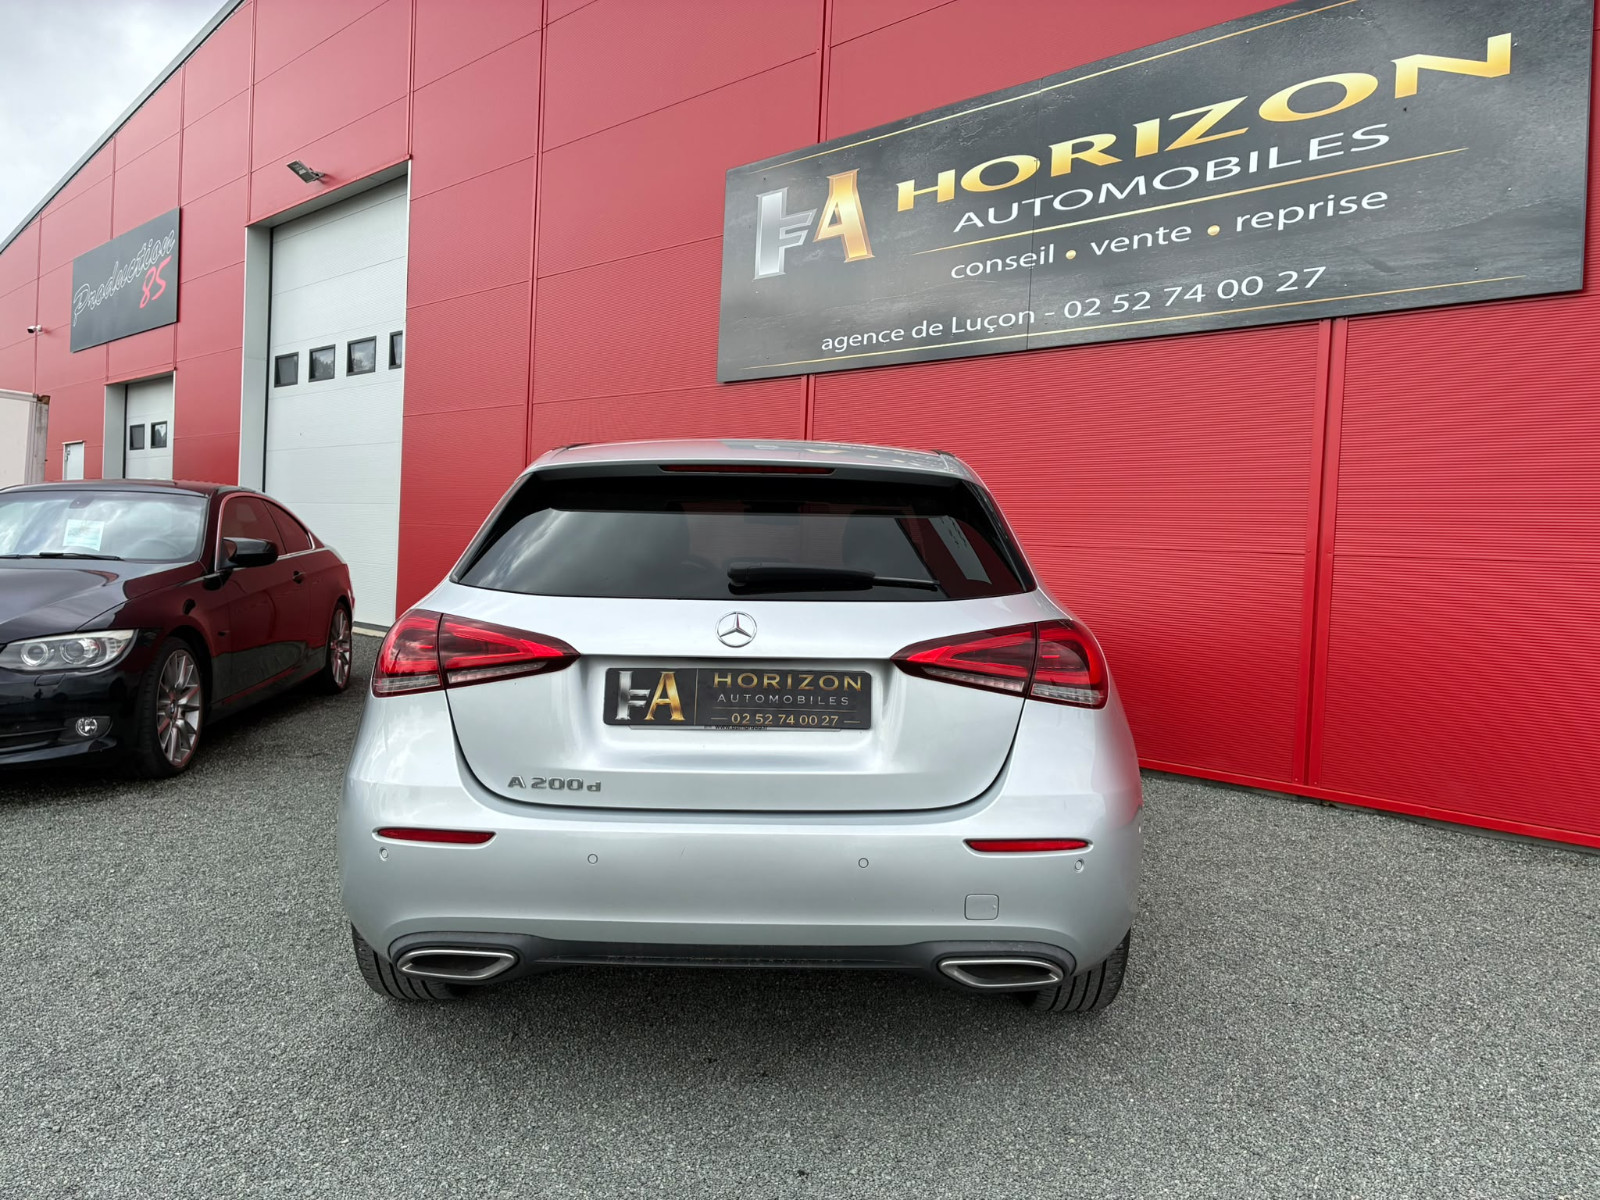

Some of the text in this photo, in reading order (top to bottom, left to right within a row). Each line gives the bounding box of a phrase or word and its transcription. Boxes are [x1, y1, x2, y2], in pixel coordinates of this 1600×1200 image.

[896, 33, 1511, 212] HORIZON
[952, 123, 1390, 233] AUTOMOBILES
[951, 191, 1388, 279] conseil vente reprise
[139, 255, 172, 309] 85
[821, 328, 905, 352] agence
[911, 320, 944, 338] de
[951, 310, 1035, 333] Luçon
[1063, 298, 1101, 319] 02
[1111, 291, 1151, 312] 52
[1163, 284, 1206, 307] 74
[1217, 276, 1264, 299] 00
[1276, 266, 1327, 293] 27
[713, 672, 862, 692] HORIZON
[717, 694, 849, 706] AUTOMOBILES
[731, 713, 839, 727] 02 52 74 00 27
[507, 775, 526, 788] A
